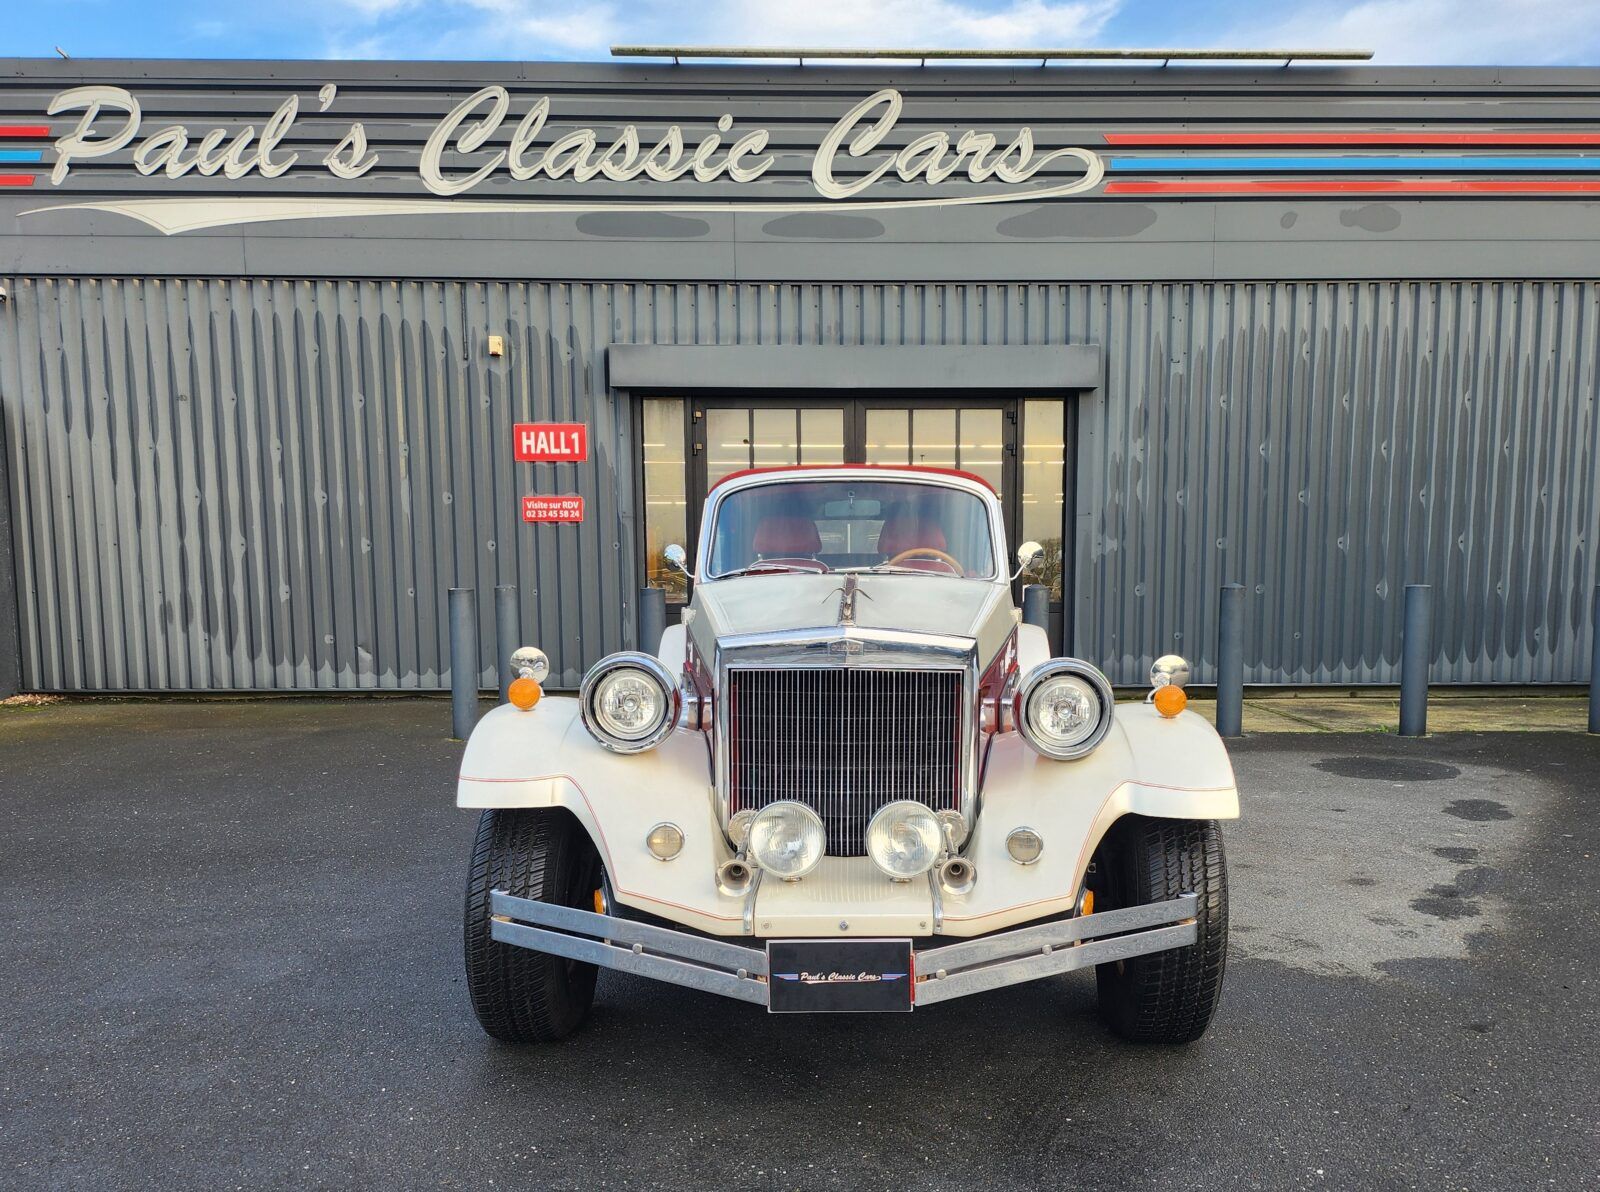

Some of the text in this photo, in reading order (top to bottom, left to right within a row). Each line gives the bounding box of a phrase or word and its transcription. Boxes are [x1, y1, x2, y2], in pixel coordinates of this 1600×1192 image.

[47, 83, 1104, 198] Paul's Classic Cars
[526, 501, 548, 509] Visite
[562, 501, 579, 509] RDV
[526, 510, 580, 518] 02 33 45 58 24
[800, 972, 881, 981] Paul's Classic Cars
